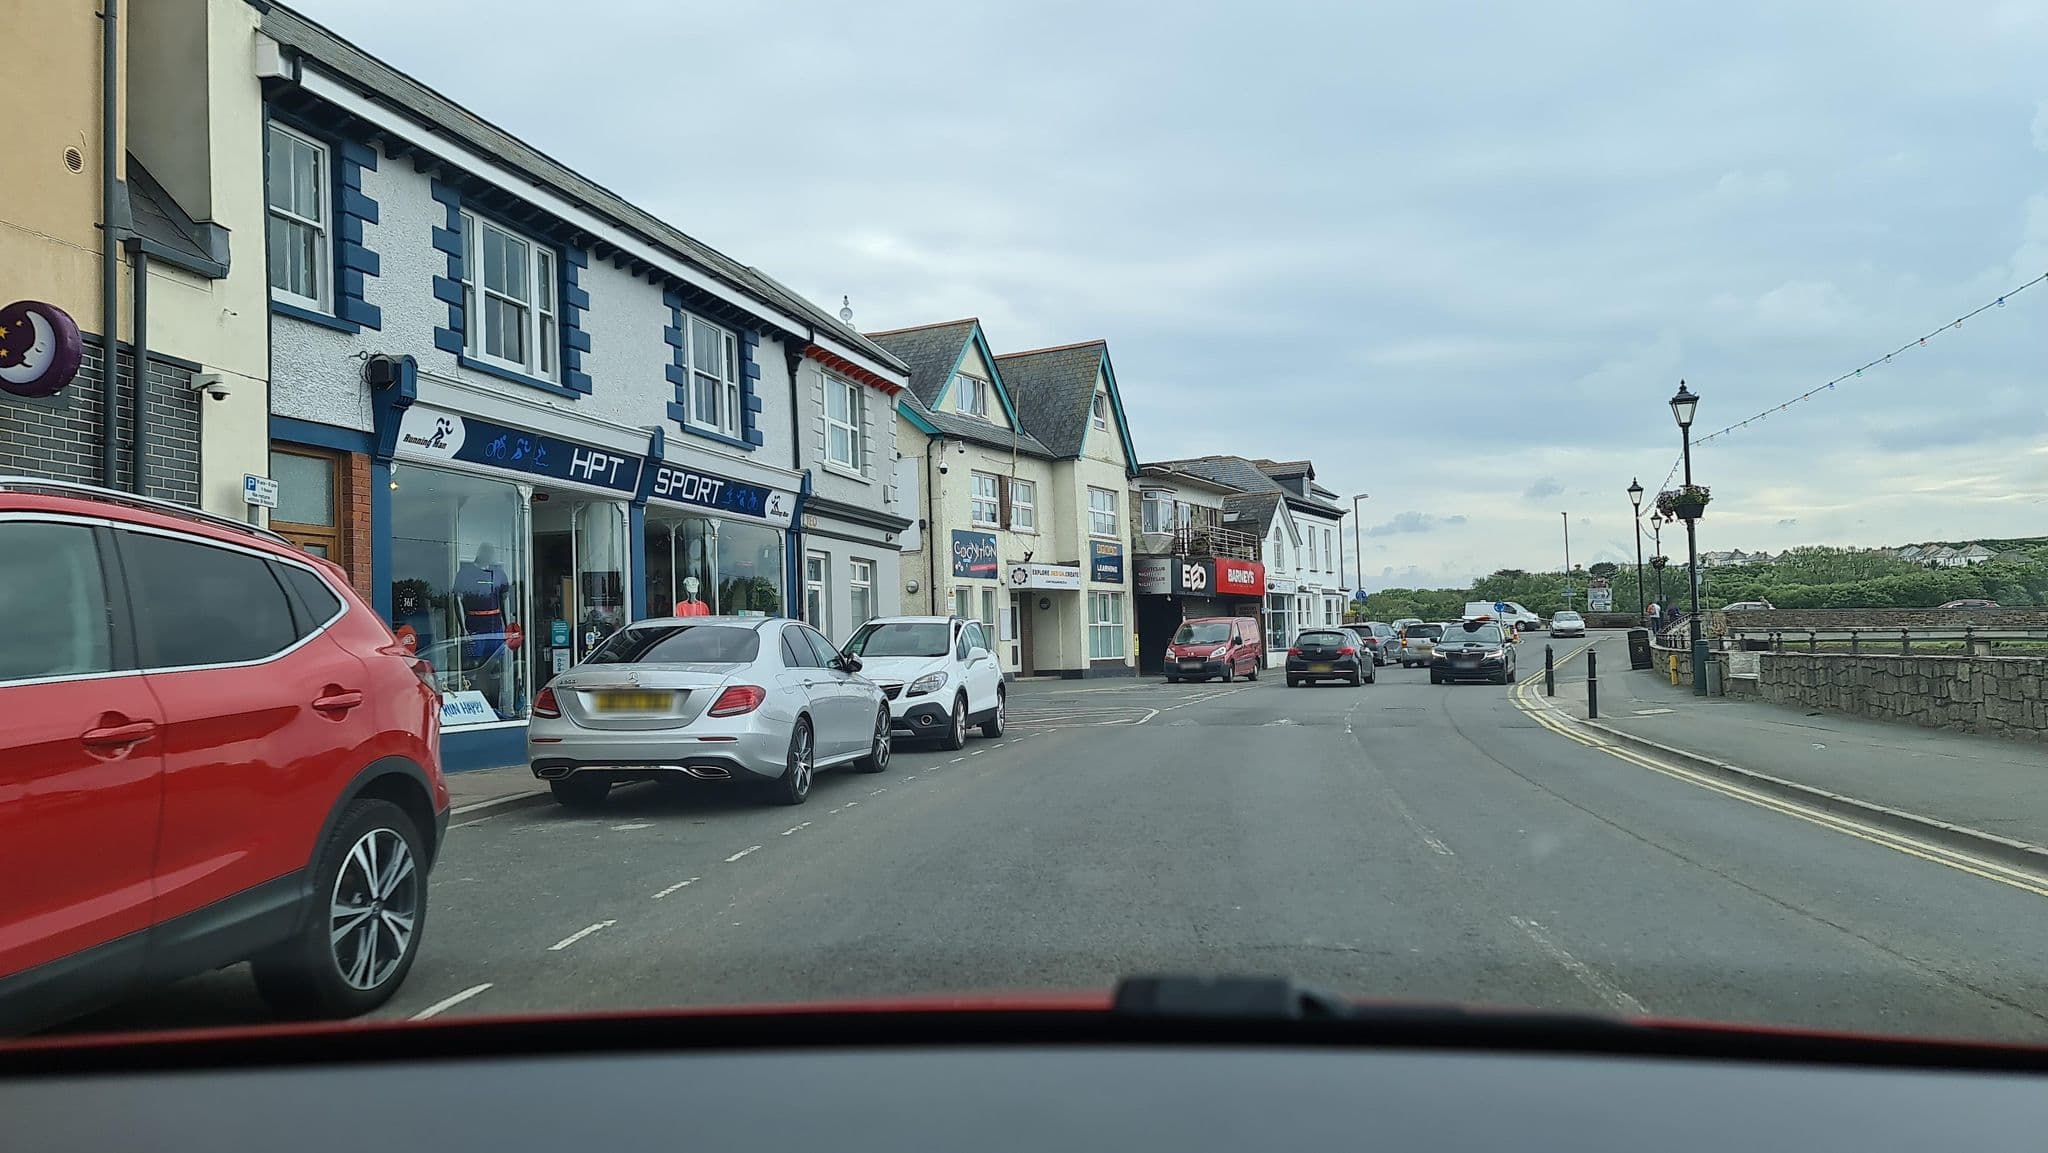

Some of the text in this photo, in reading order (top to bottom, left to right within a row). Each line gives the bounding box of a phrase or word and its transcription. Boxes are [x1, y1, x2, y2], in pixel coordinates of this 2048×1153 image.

[403, 433, 447, 449] Running Man
[569, 448, 625, 484] HPT
[654, 467, 725, 504] SPORT
[443, 702, 461, 718] RUN
